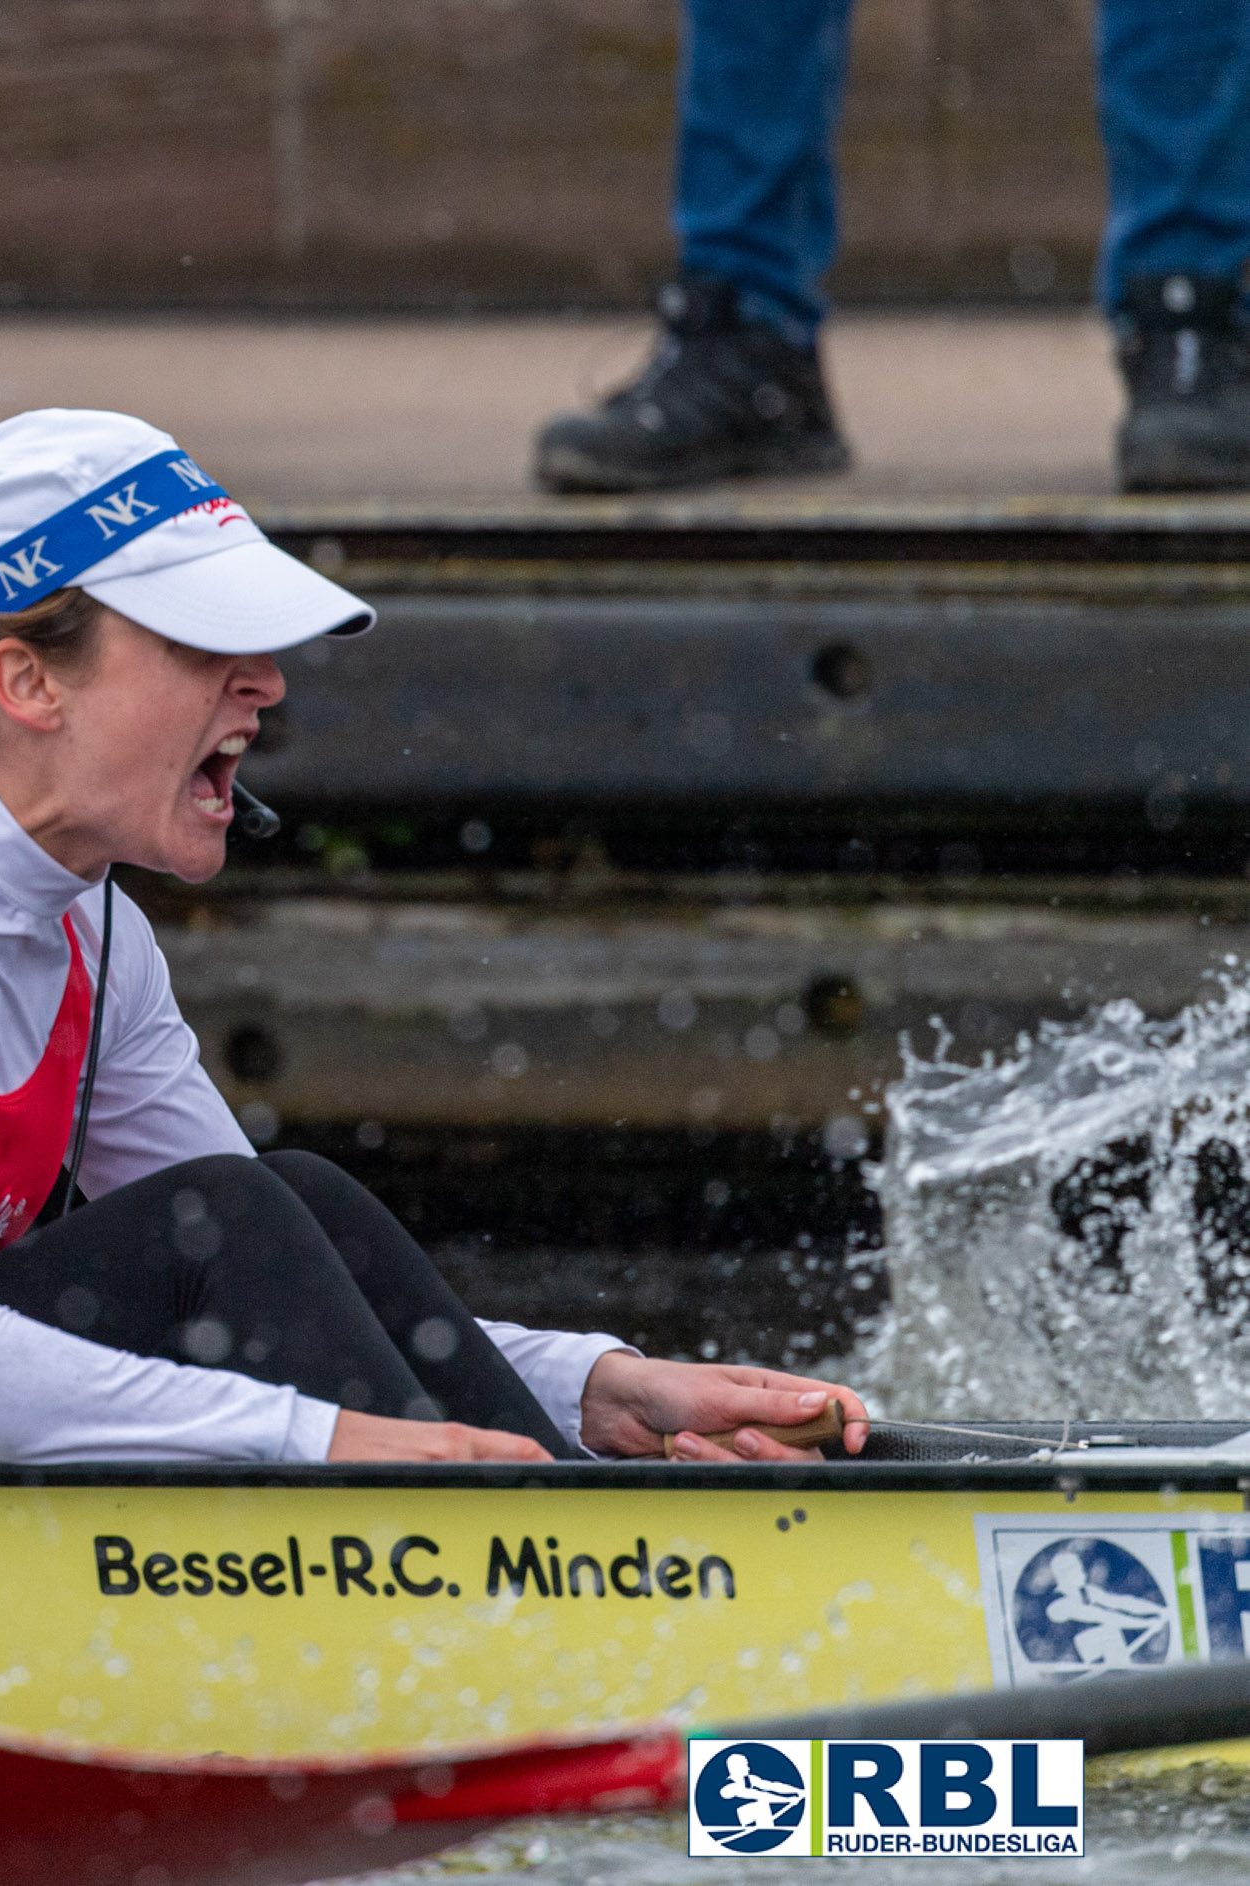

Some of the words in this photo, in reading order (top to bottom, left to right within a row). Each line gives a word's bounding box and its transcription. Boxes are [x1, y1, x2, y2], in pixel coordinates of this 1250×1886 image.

[84, 481, 160, 541] NK
[94, 1535, 461, 1597] Bessel-R.C.
[486, 1536, 736, 1600] Minden
